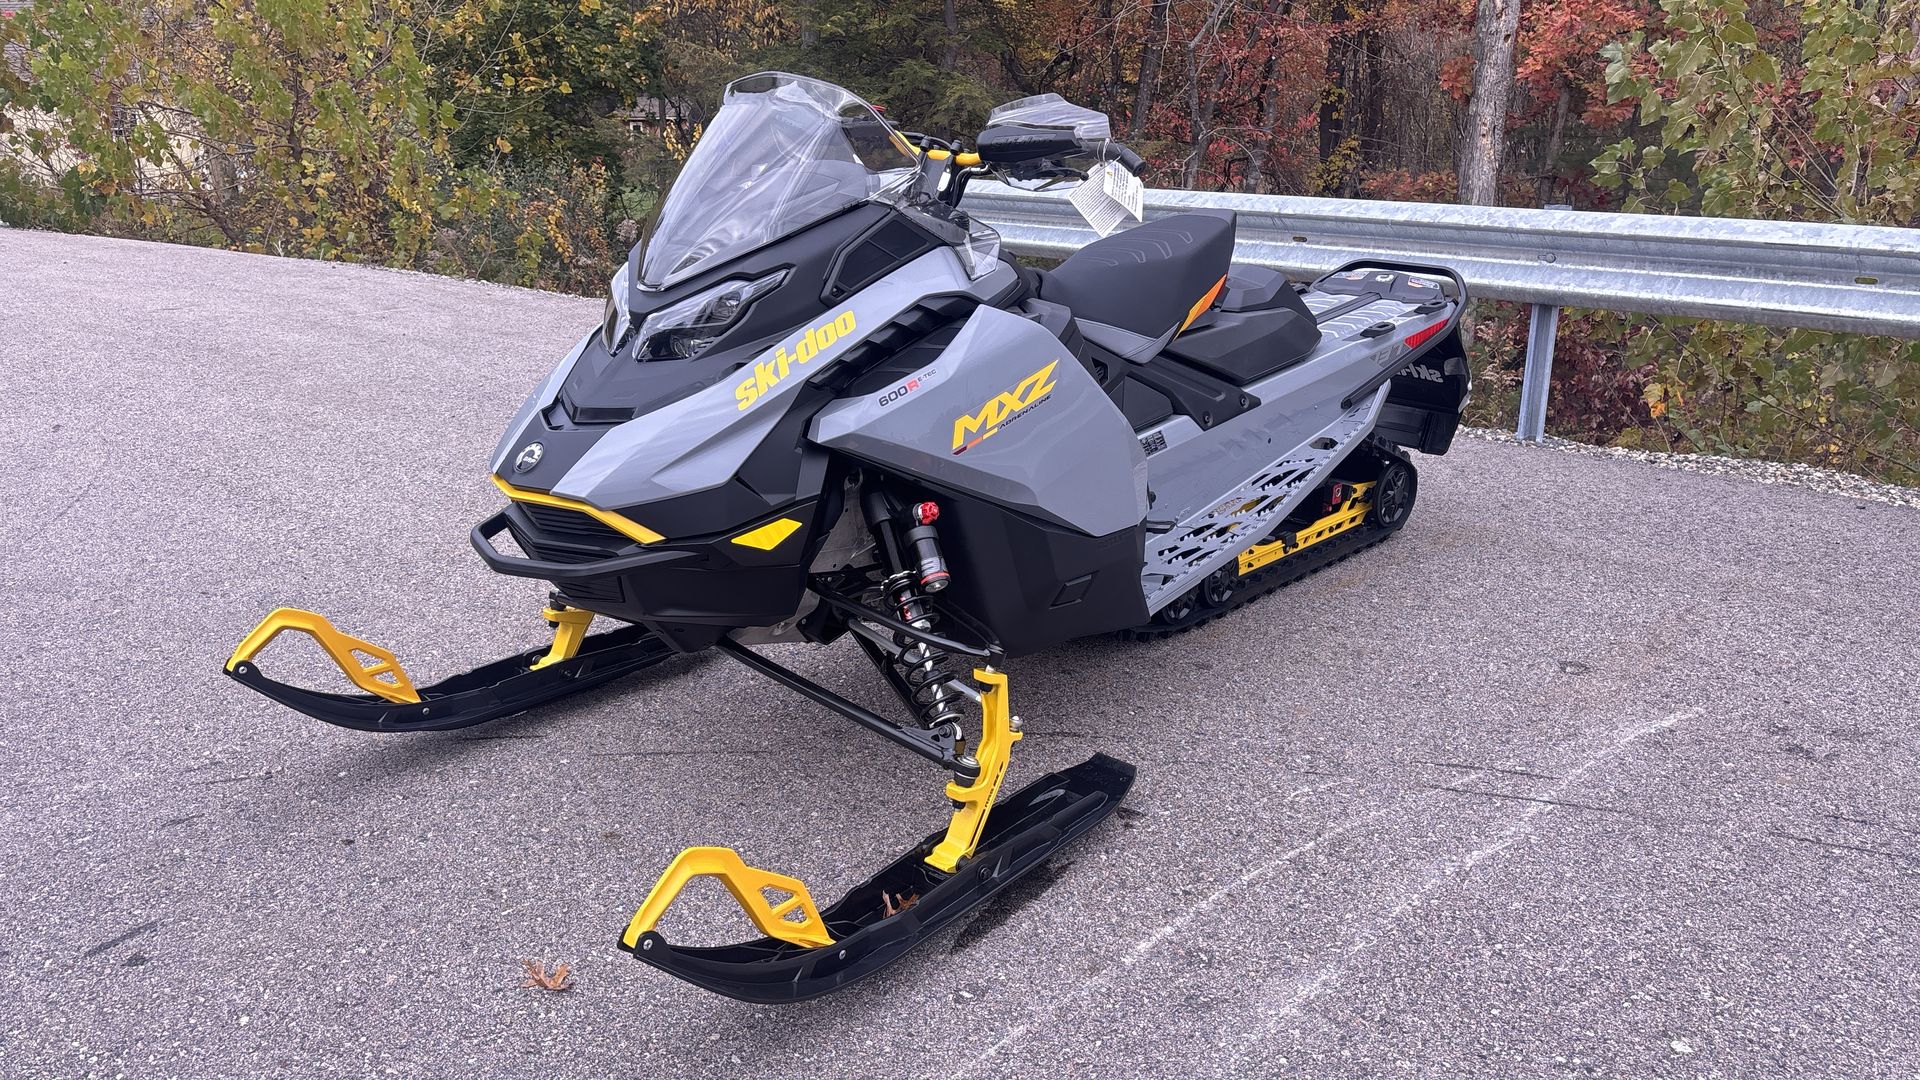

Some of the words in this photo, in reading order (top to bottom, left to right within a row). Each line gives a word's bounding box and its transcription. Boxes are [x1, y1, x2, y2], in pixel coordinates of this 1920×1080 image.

[734, 310, 856, 411] ski-doo
[878, 379, 920, 408] 600R
[952, 359, 1059, 449] MXZ
[1000, 394, 1052, 429] ADRENALINE
